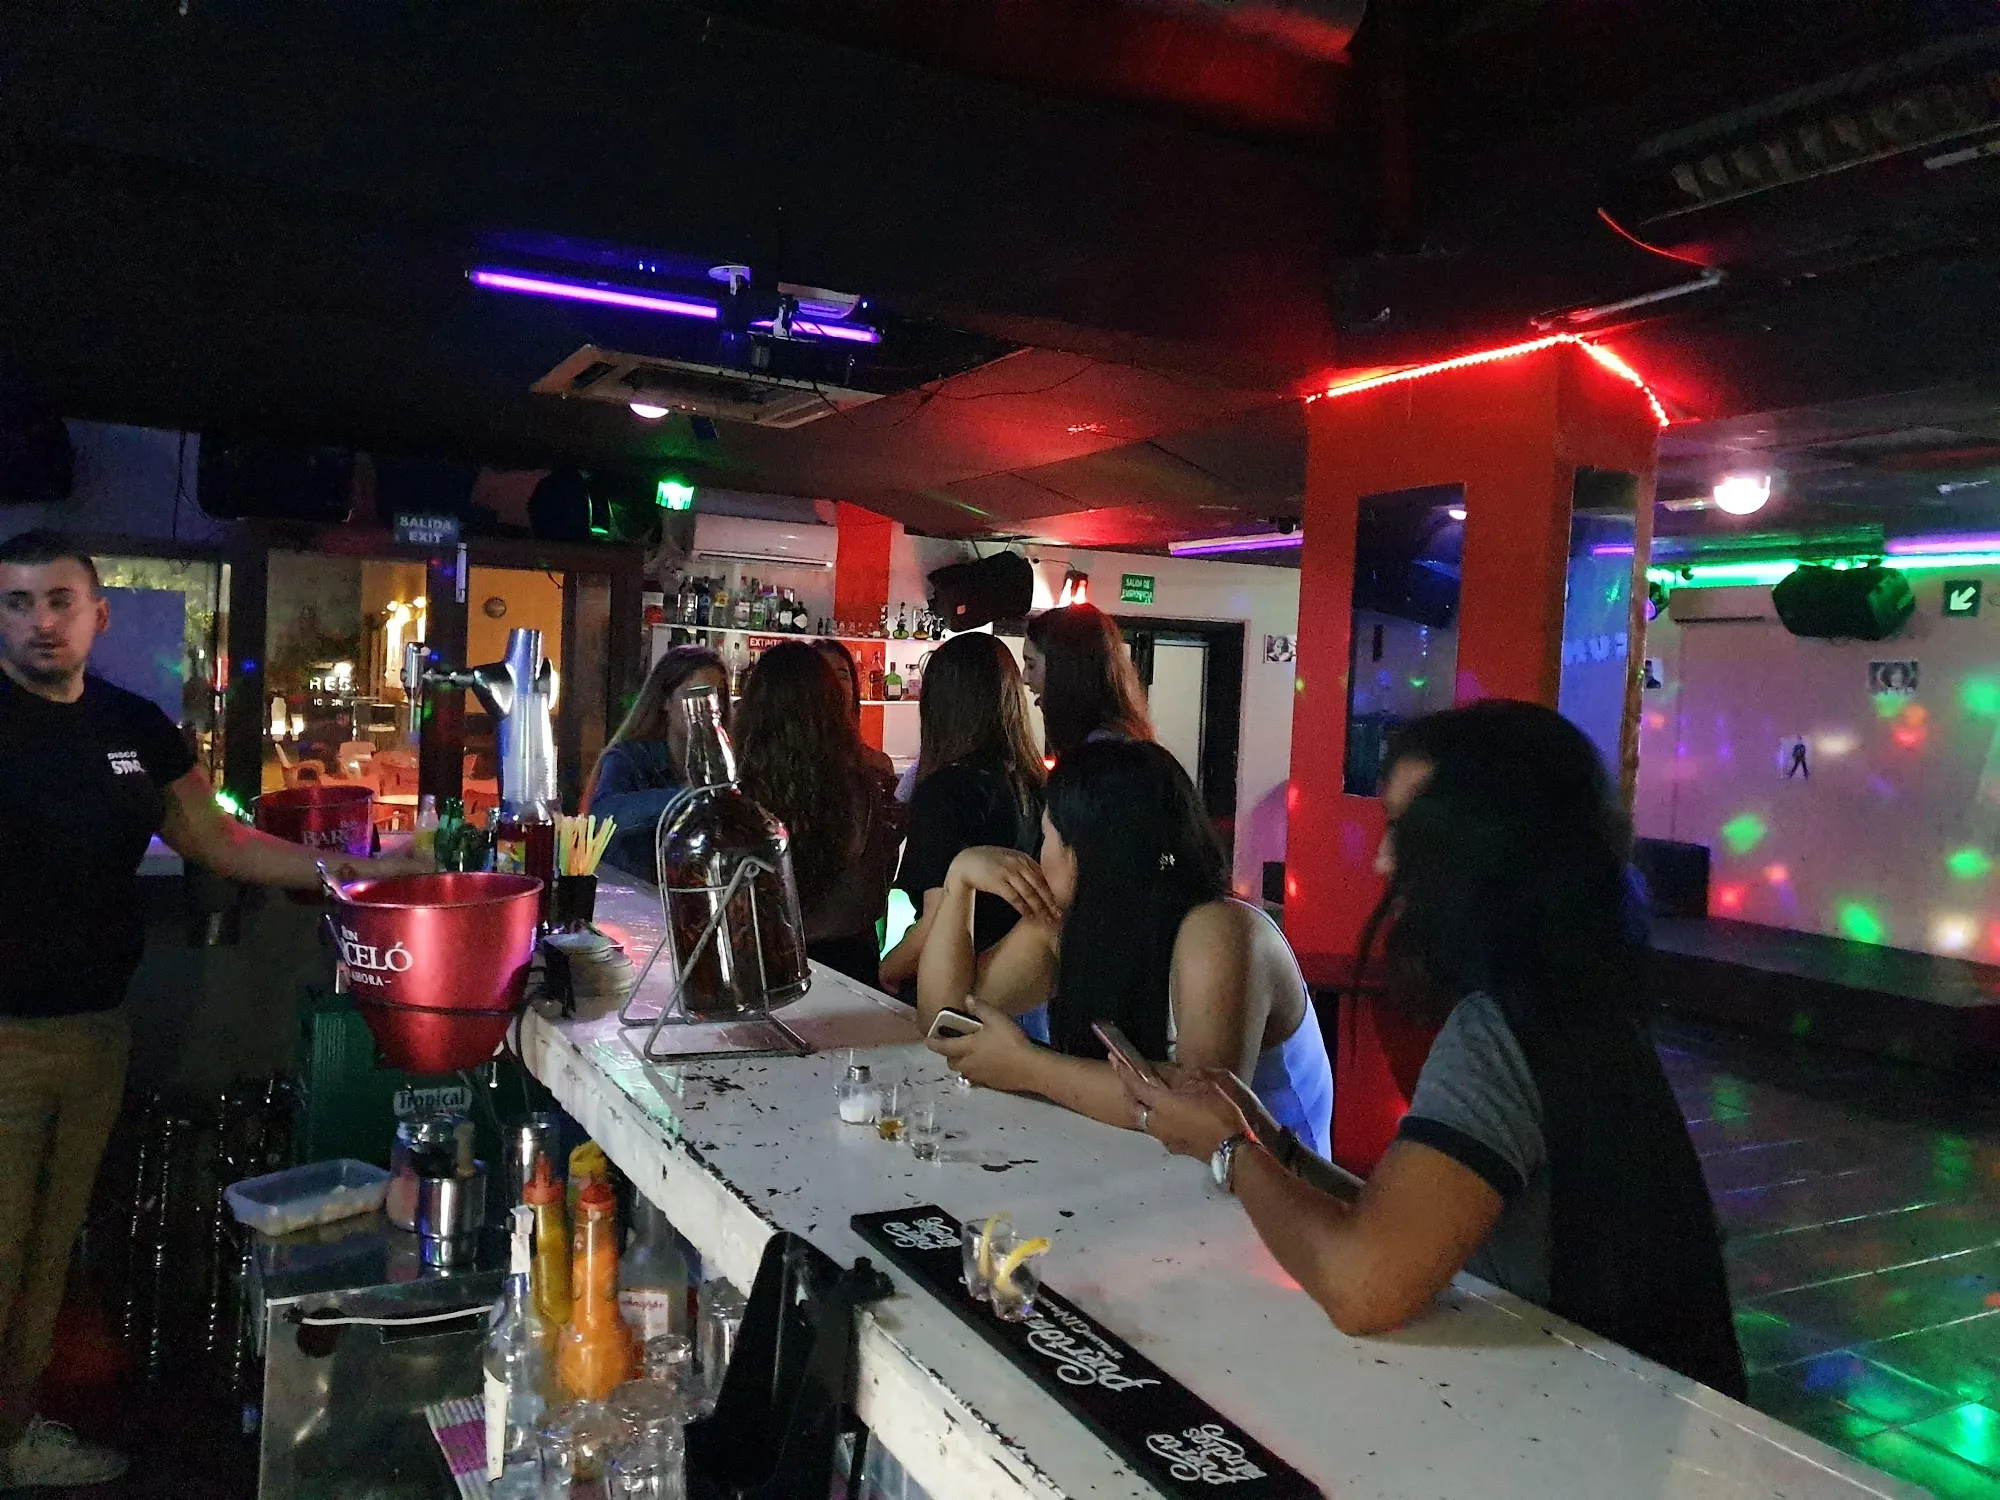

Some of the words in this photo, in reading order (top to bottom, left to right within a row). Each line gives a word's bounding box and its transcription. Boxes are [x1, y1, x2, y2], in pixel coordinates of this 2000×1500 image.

[400, 515, 452, 530] SALIDA
[408, 531, 444, 544] EXIT
[397, 1087, 465, 1110] Tropical
